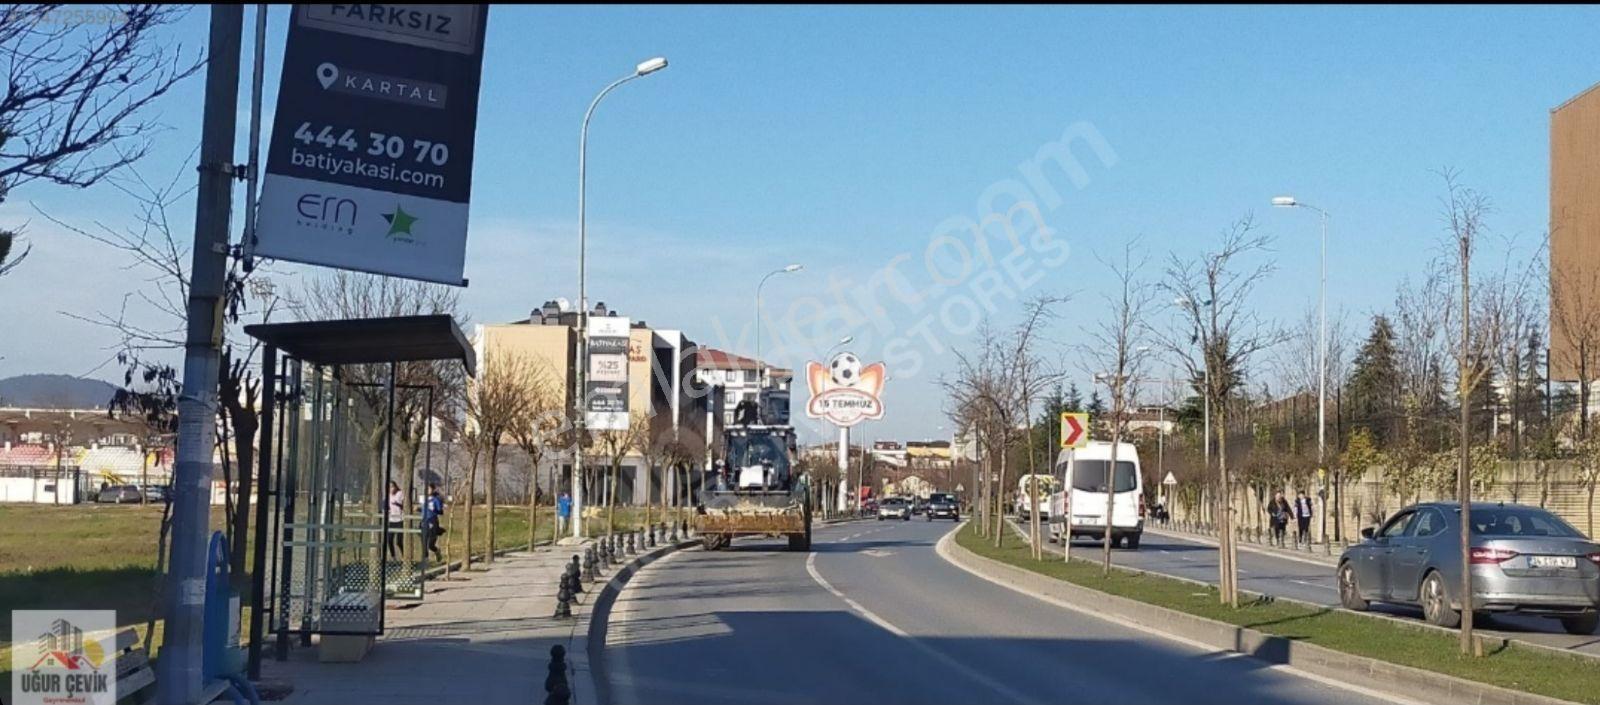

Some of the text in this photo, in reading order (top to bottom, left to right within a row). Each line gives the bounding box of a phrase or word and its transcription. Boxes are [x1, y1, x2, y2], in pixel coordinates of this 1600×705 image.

[344, 75, 438, 102] KARTAL
[293, 121, 450, 166] 444 30 70
[291, 148, 445, 188] batiyakasi.com
[832, 399, 873, 408] TEMMUZ
